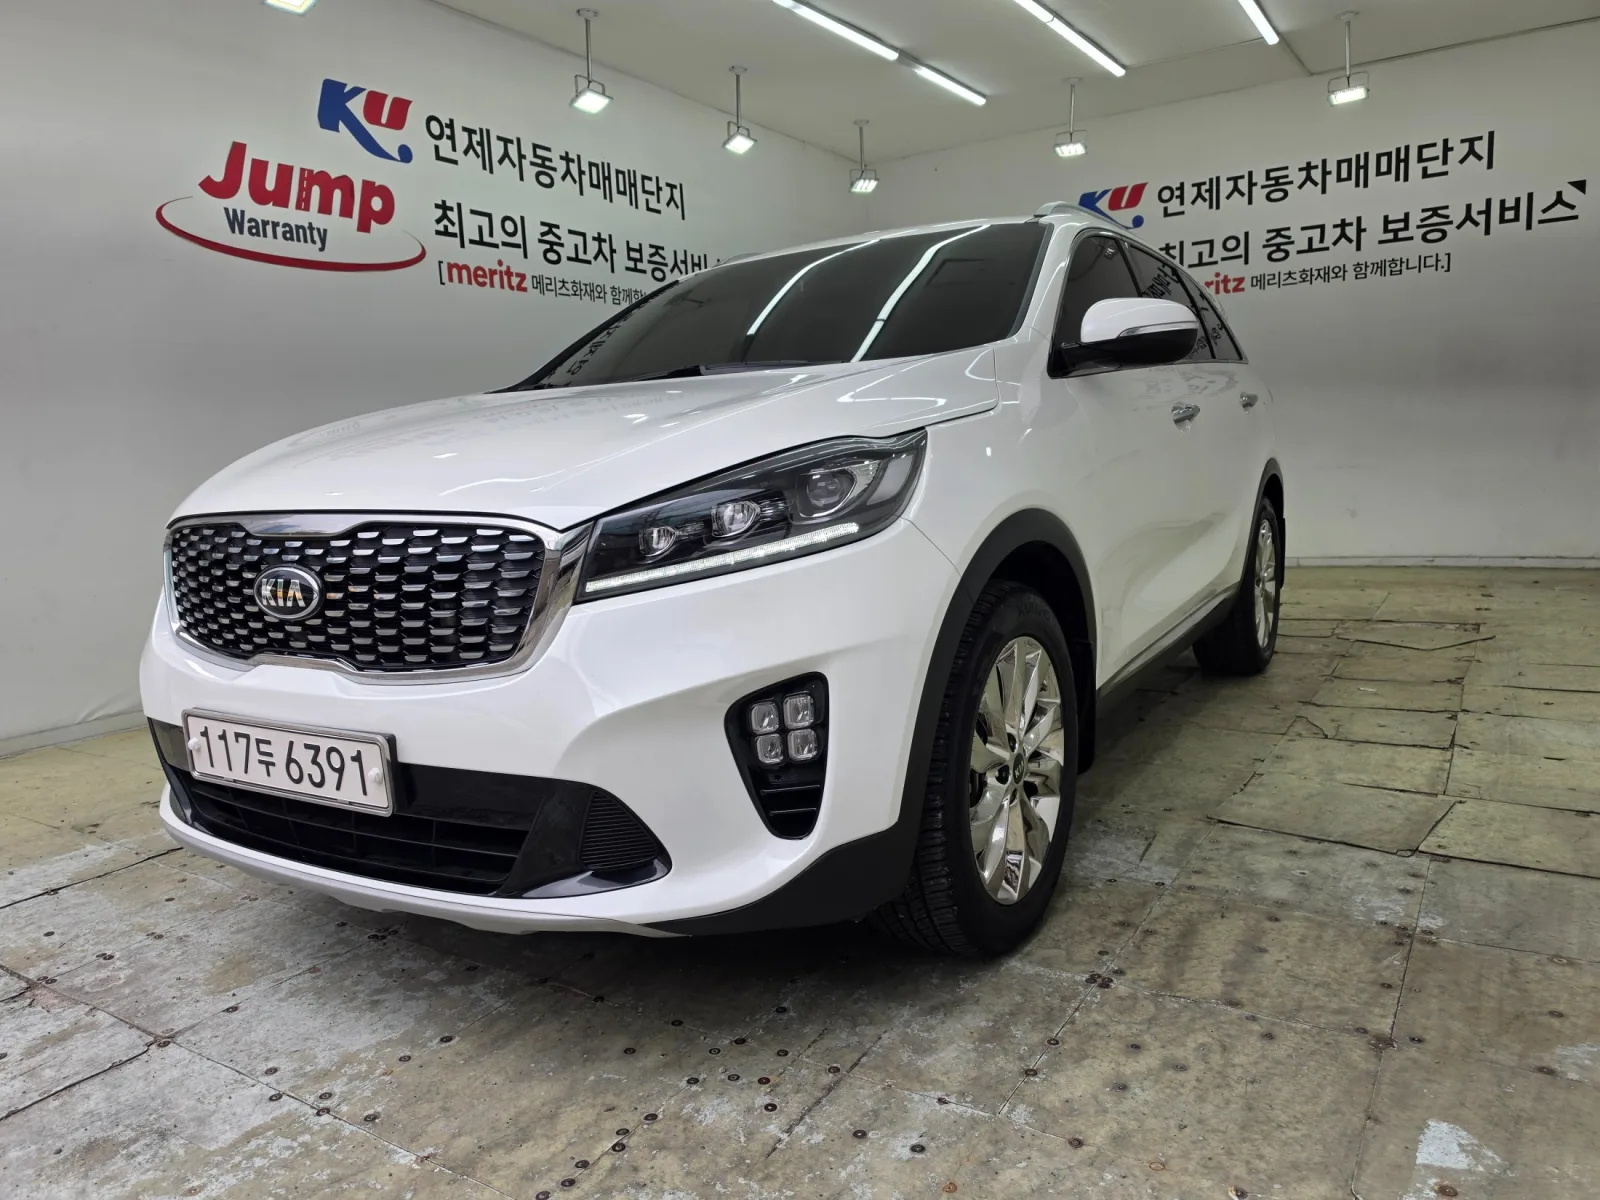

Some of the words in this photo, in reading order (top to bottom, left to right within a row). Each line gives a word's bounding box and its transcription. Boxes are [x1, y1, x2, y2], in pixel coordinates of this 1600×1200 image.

[198, 141, 396, 234] Jump
[425, 114, 686, 221] 연제자동차매매단지
[1157, 130, 1495, 218] 연제자동차매매단지
[223, 207, 328, 252] Warranty
[434, 199, 528, 259] 최고의
[537, 221, 617, 274] 중고차
[624, 239, 720, 283] 보증서비
[1262, 216, 1367, 263] 중고차
[1377, 190, 1579, 245] 보증서비스
[531, 274, 608, 304] 메리츠화재와
[1250, 263, 1349, 291] 메리츠화재와
[1352, 252, 1452, 281] 함께합니다.]
[261, 578, 306, 607] KIA
[199, 725, 276, 777] 117두
[285, 740, 368, 796] 6391
